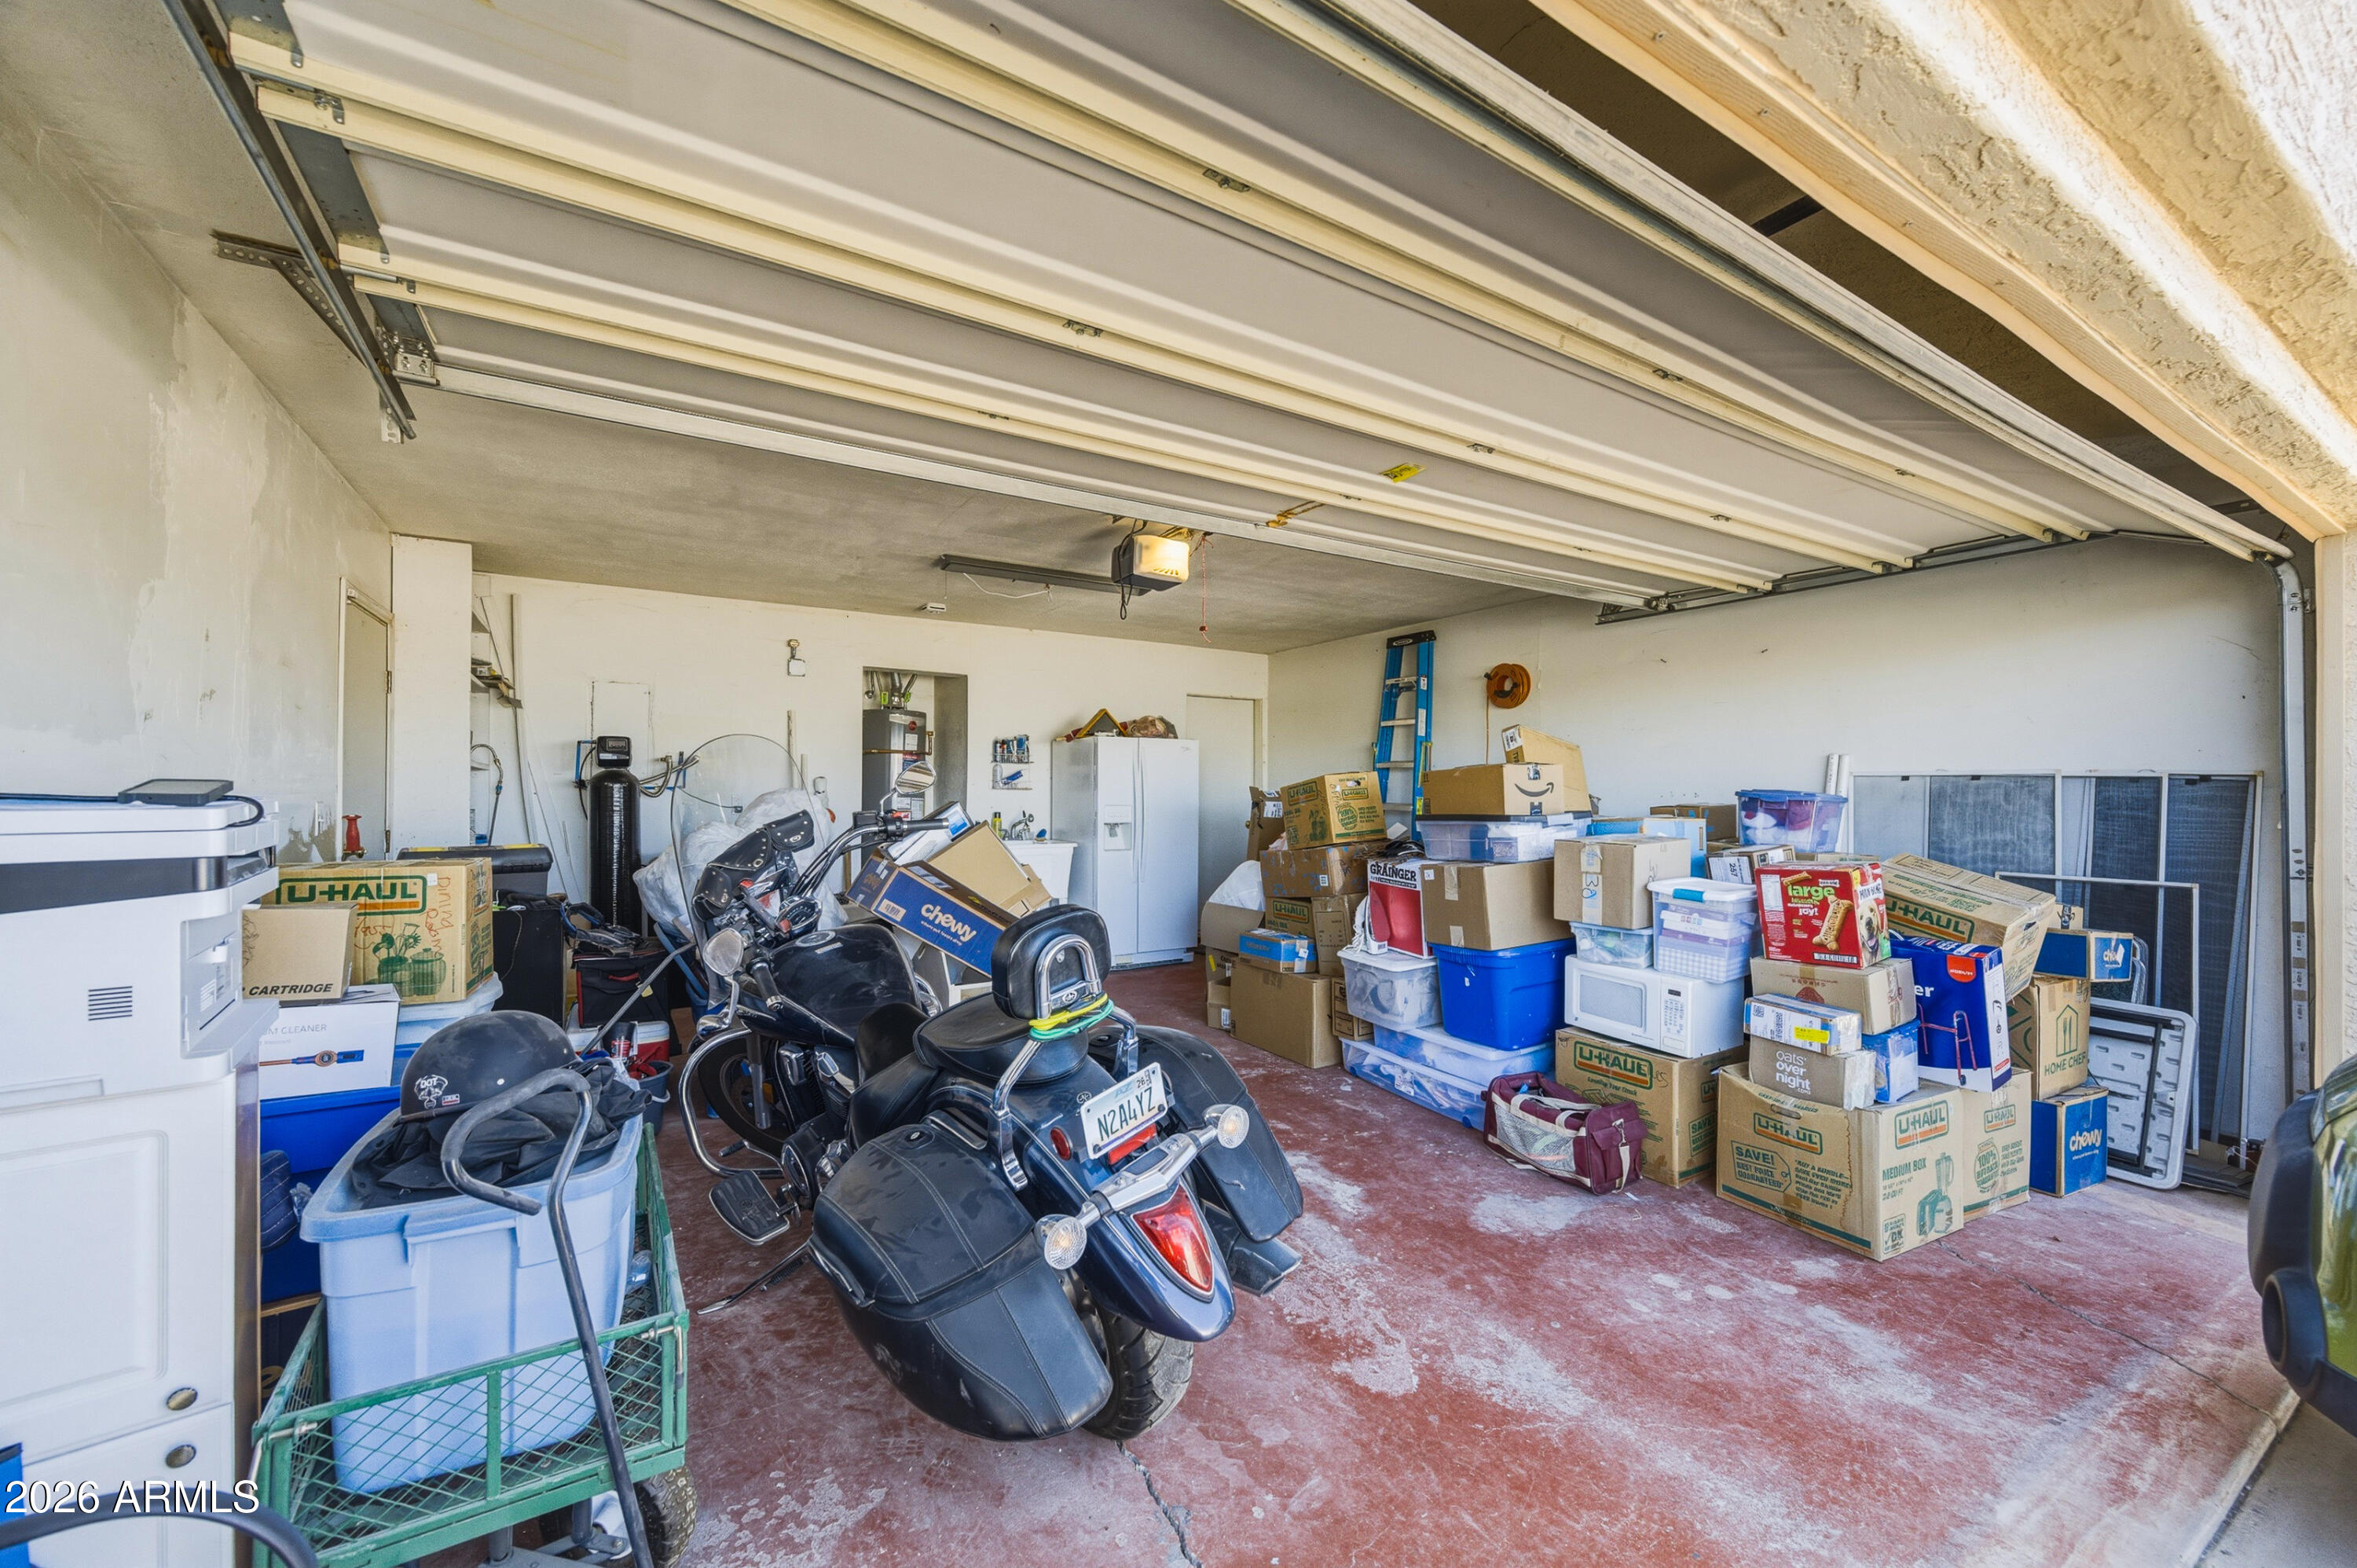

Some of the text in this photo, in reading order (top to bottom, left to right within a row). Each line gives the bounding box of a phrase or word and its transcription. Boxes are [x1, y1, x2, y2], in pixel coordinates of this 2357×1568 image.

[1369, 863, 1417, 881] GRAINGER
[287, 881, 418, 903] U-HAUL
[1787, 885, 1835, 901] large
[921, 904, 977, 943] chewy
[249, 984, 333, 996] CARTRIDGE
[281, 1024, 328, 1035] CLEANER
[1776, 1061, 1806, 1075] over
[2044, 1052, 2086, 1075] HOME CHEF
[420, 1077, 438, 1089] DOT
[1776, 1072, 1811, 1090] night
[1097, 1086, 1156, 1142] N2A4YZ
[1898, 1106, 1945, 1134] U-HAUL
[2069, 1129, 2102, 1152] chewy
[1735, 1145, 1775, 1166] SAVE!
[1882, 1157, 1926, 1181] MEDIUM BOX
